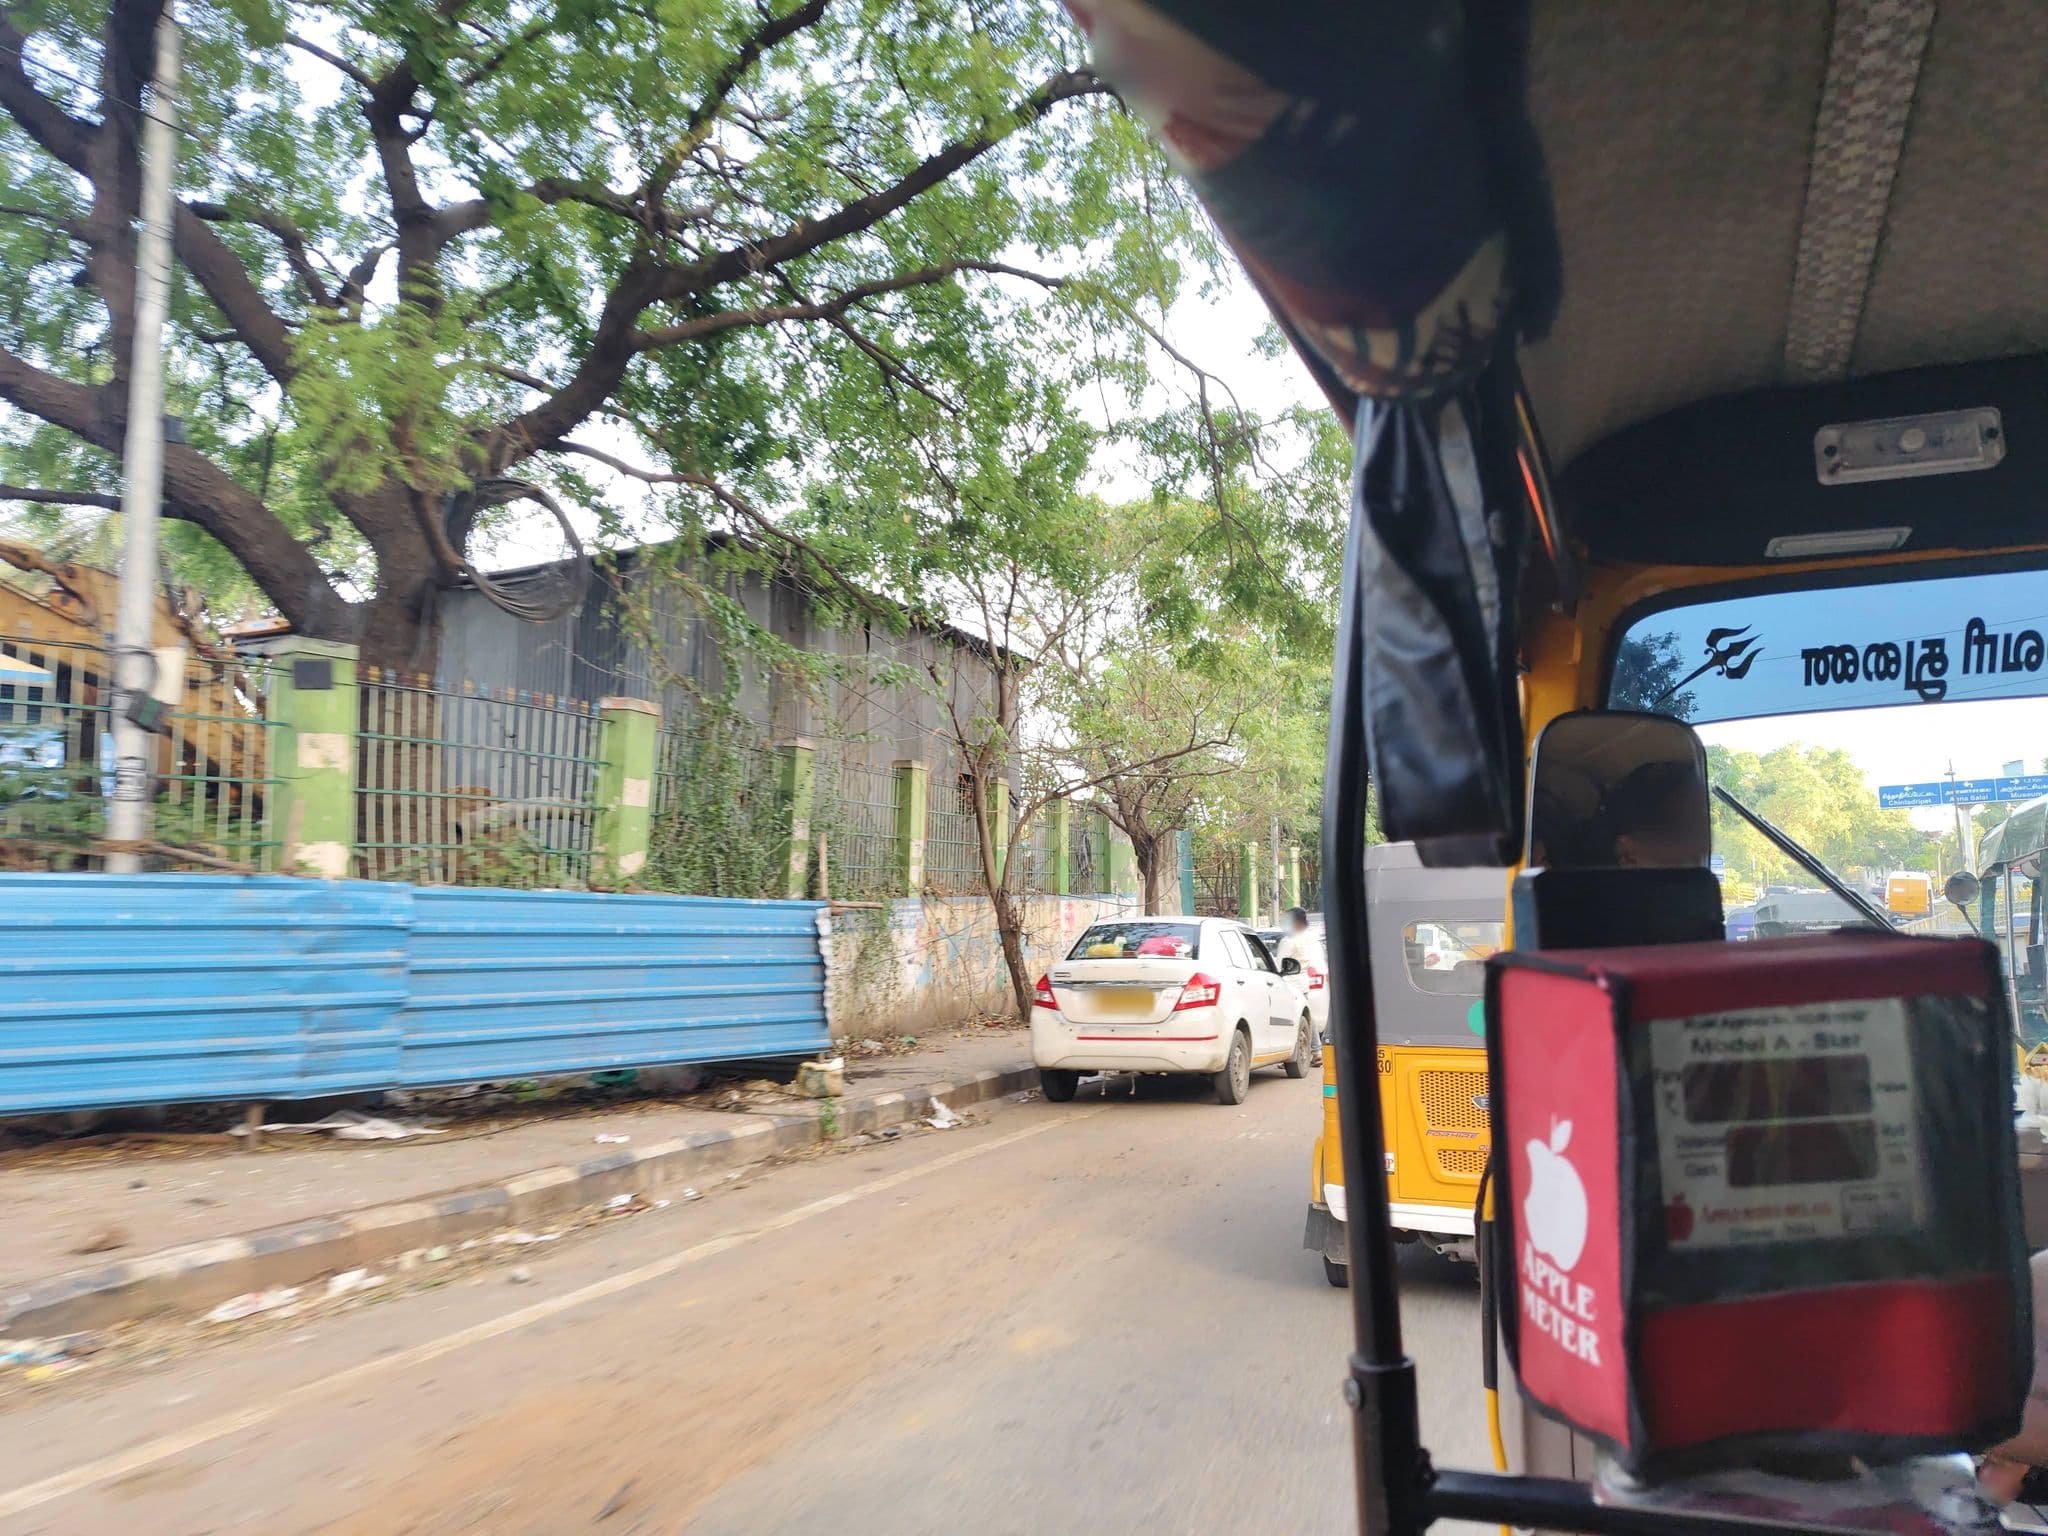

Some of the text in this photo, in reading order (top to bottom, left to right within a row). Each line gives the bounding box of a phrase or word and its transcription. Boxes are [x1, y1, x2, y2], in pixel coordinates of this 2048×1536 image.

[1888, 798, 1932, 807] Chintadripet
[2010, 791, 2043, 799] Museum
[1690, 1035, 1766, 1055] Model
[1523, 1240, 1597, 1321] APPLE
[1523, 1283, 1601, 1367] METER
